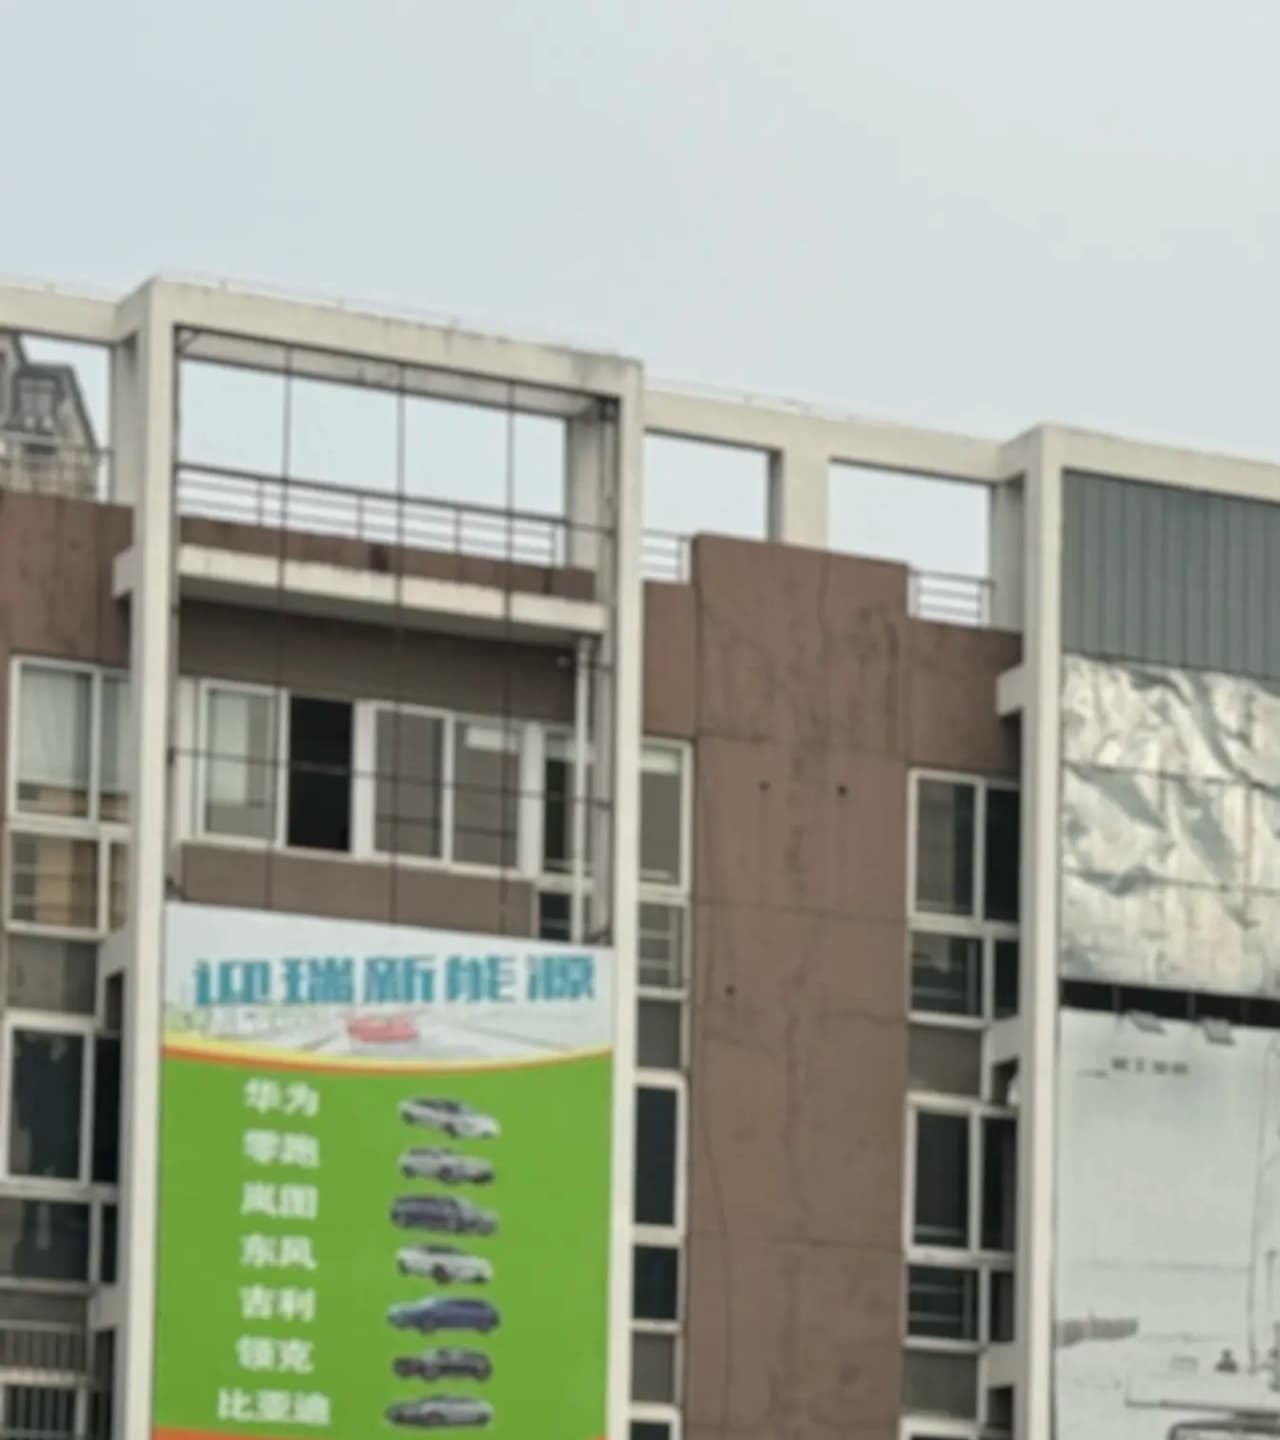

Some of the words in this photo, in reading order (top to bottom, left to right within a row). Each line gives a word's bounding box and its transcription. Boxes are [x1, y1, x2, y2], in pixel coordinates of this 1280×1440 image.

[194, 953, 596, 1006] 迎瑞新能源
[242, 1077, 320, 1117] 华为
[239, 1232, 318, 1271] 东风
[237, 1283, 317, 1323] 吉利
[216, 1387, 331, 1427] 比亚迪
